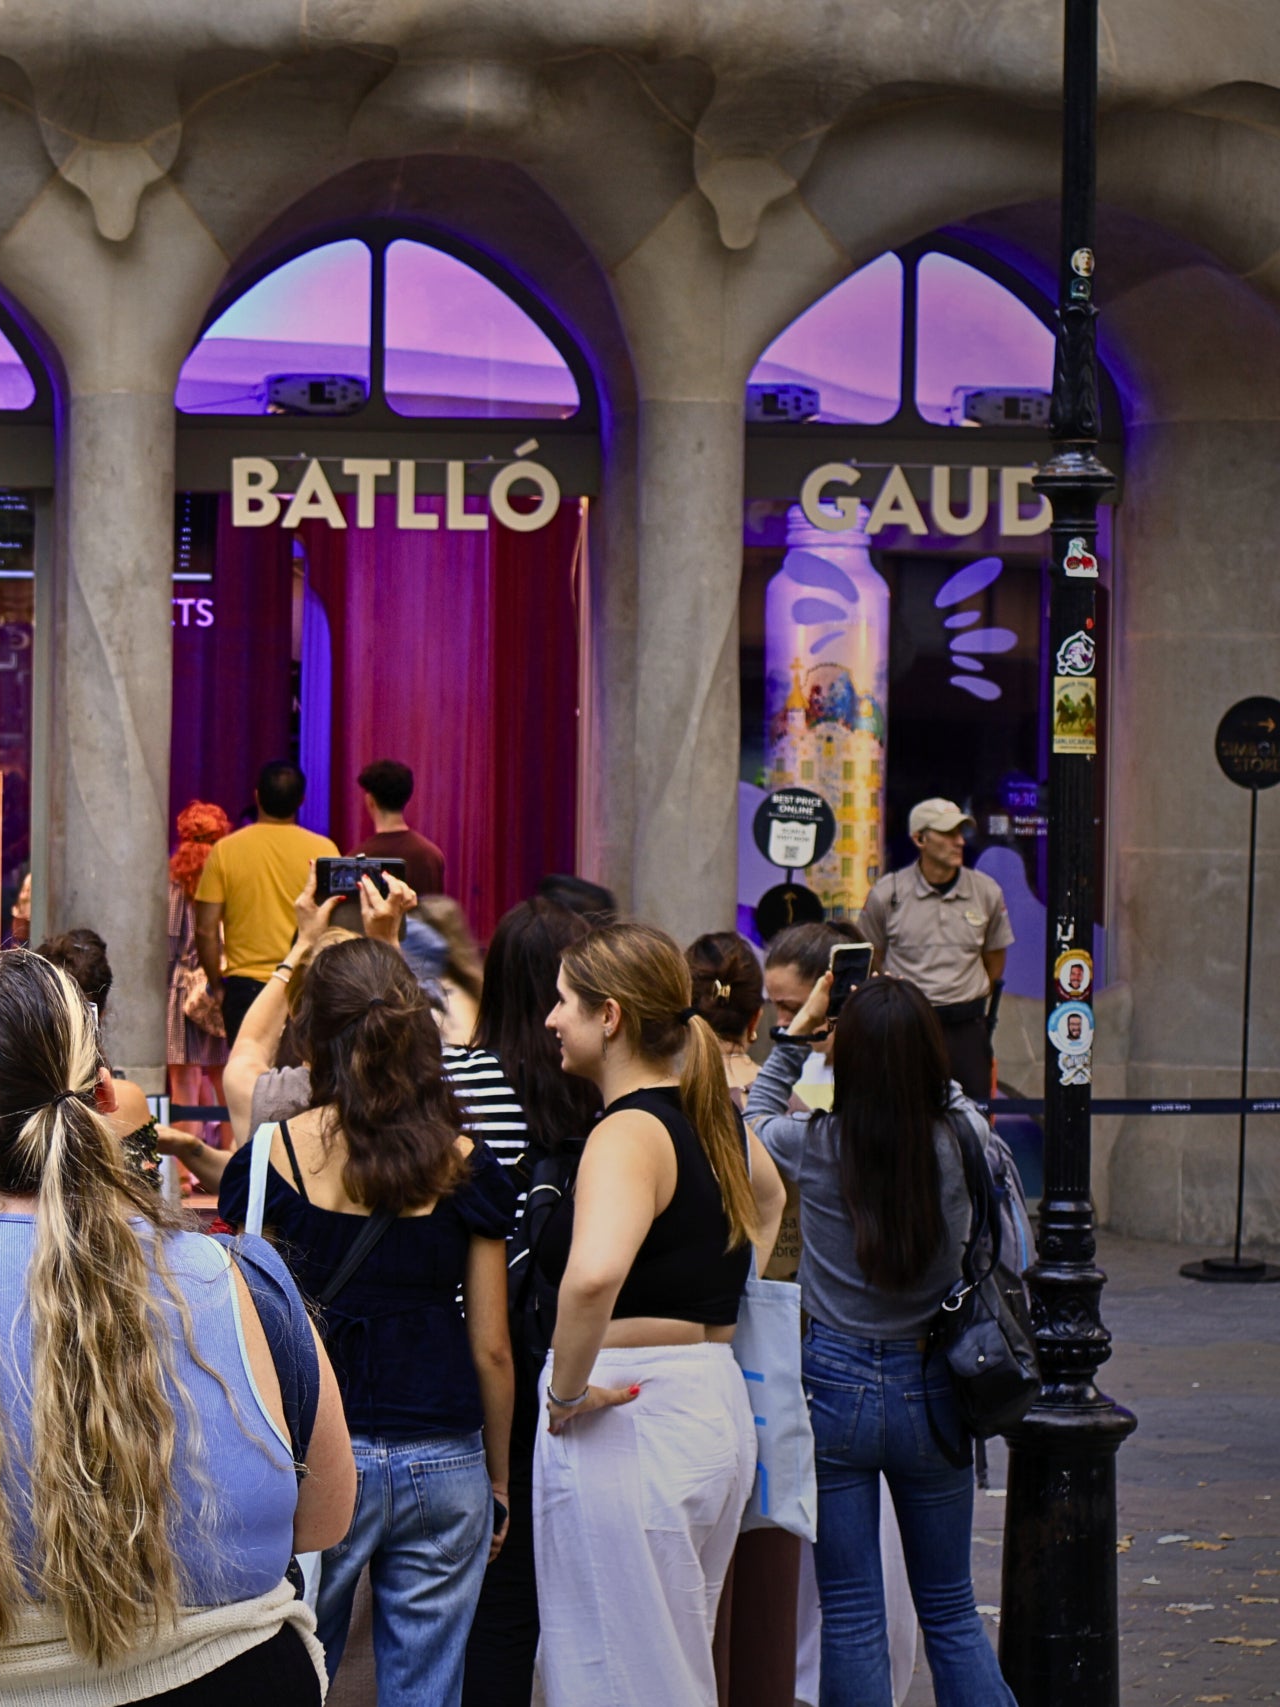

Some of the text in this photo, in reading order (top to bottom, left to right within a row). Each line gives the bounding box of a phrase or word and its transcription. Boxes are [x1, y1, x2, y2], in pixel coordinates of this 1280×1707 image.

[232, 438, 560, 532] BATLLÓ
[801, 463, 1053, 536] GAUD
[170, 598, 215, 627] TS
[772, 794, 823, 808] BEST PRICE
[778, 805, 815, 816] ONLINE
